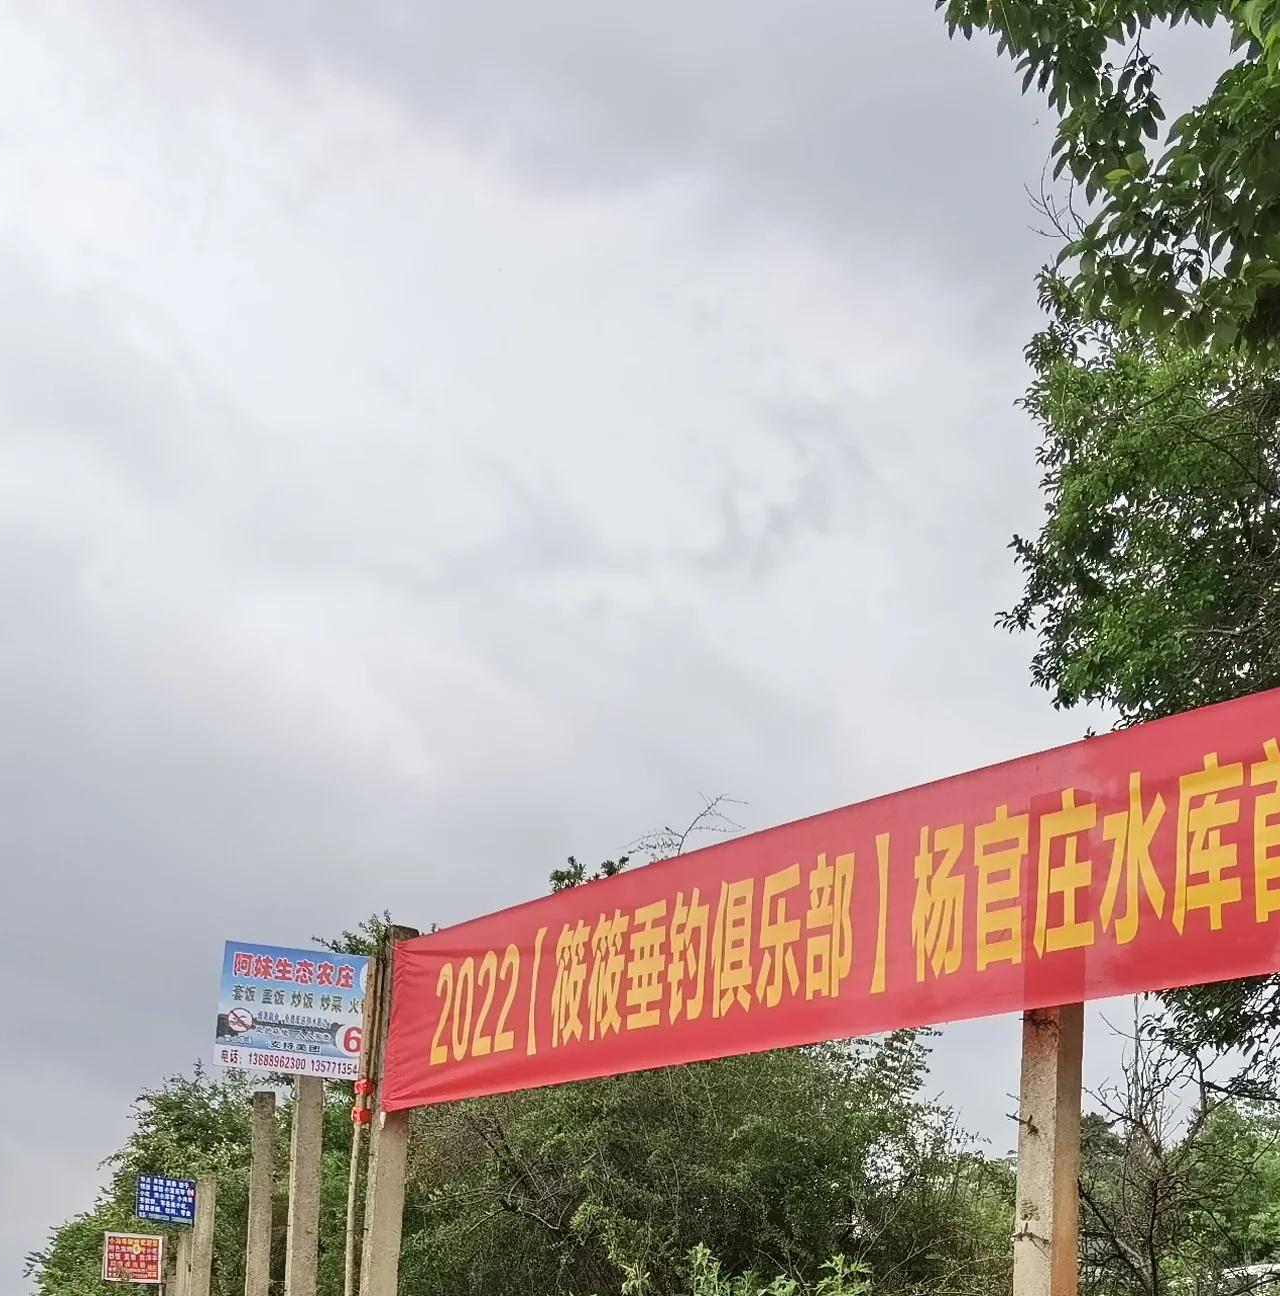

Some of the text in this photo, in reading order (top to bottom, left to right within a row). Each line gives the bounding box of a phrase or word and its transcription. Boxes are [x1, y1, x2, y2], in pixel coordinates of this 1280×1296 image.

[233, 952, 355, 989] 阿妹生态农庄
[291, 990, 314, 1009] 炒饭
